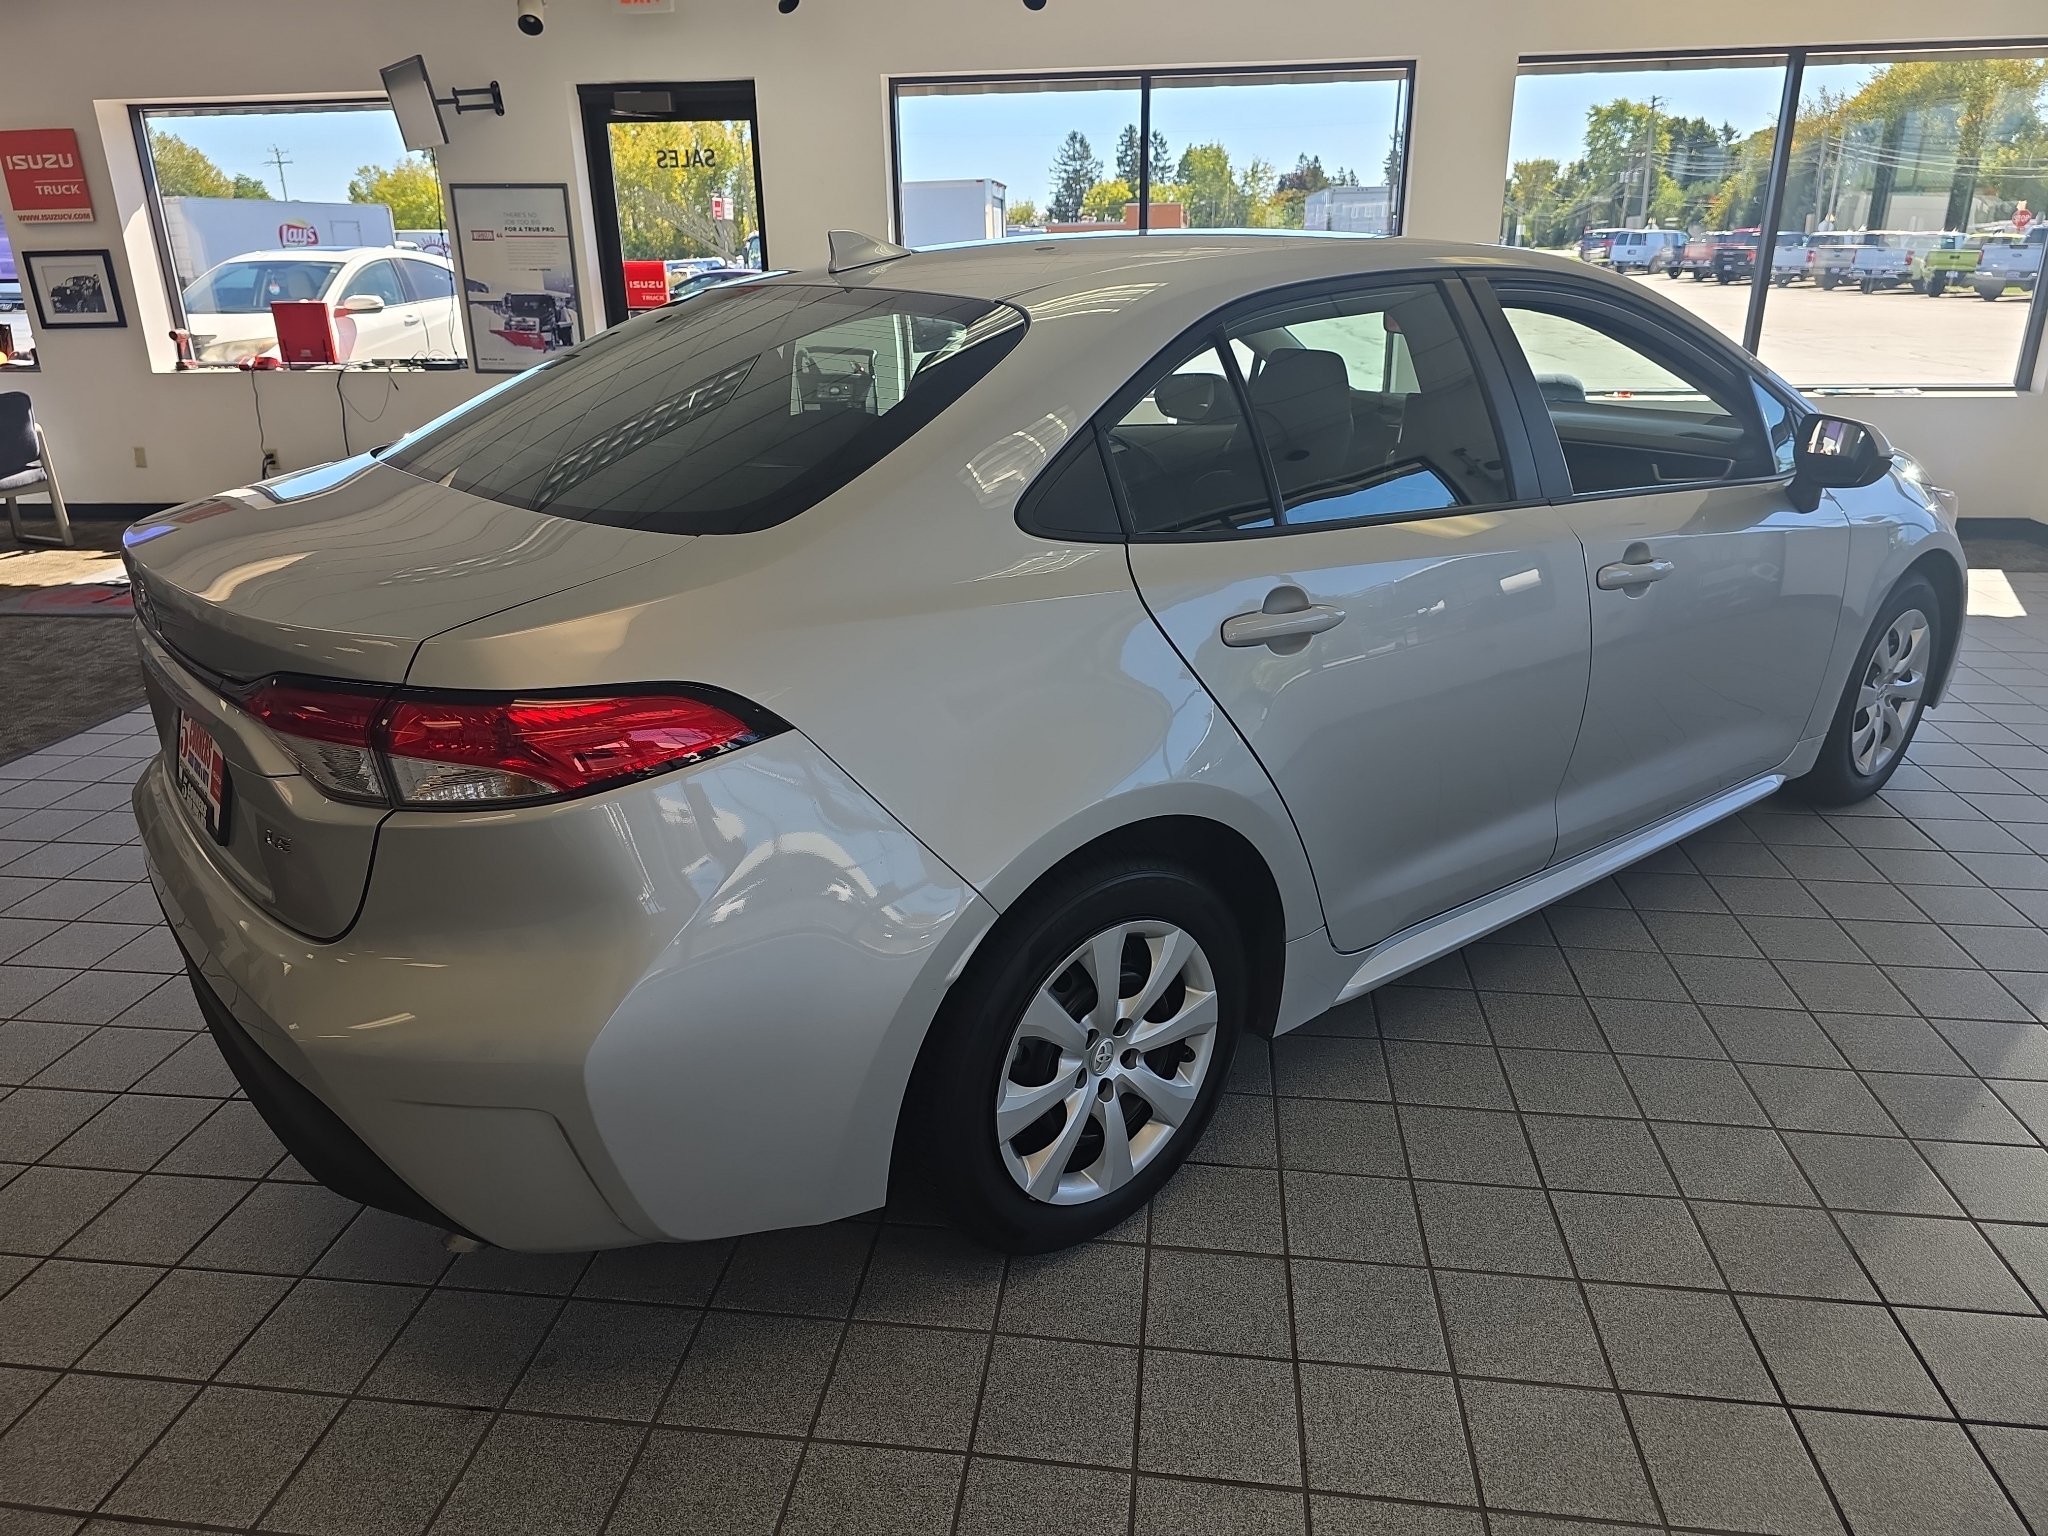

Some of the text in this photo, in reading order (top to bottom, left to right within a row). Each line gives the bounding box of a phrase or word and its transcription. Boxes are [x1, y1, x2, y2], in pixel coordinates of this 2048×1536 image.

[6, 153, 73, 170] ISUZU
[35, 184, 81, 195] TRUCK
[18, 213, 90, 221] WWW.ISUZUCV.COM
[629, 280, 664, 289] ISUZU
